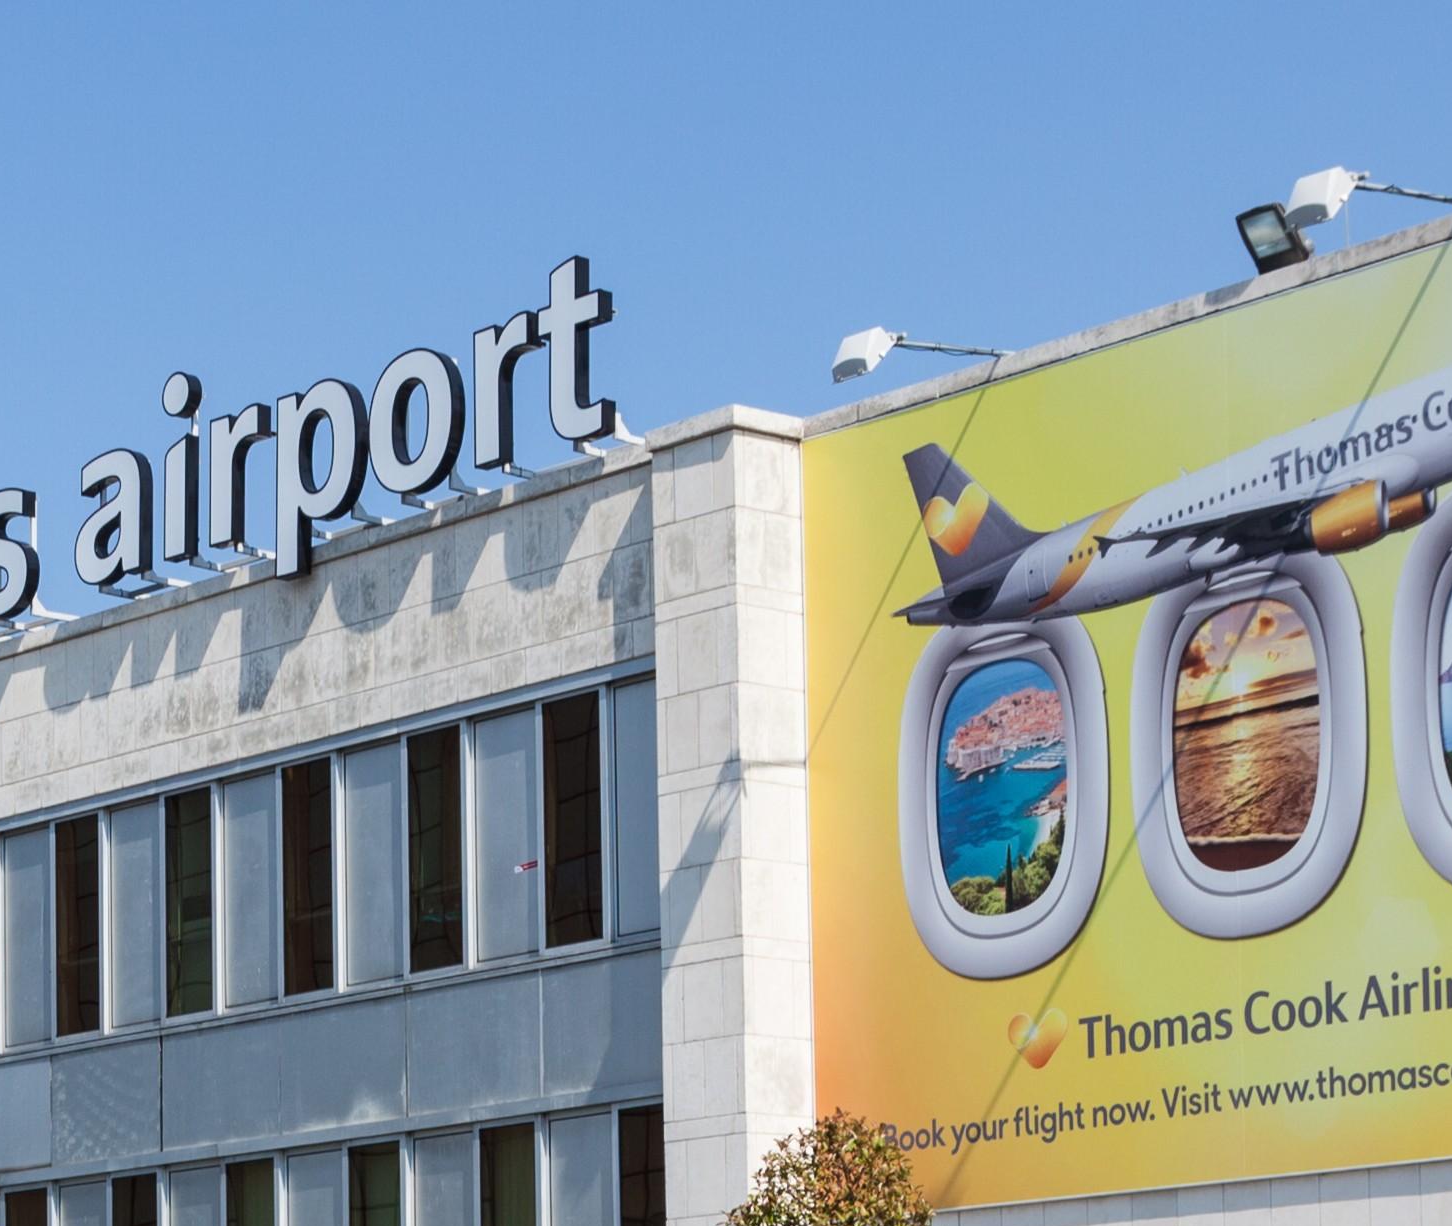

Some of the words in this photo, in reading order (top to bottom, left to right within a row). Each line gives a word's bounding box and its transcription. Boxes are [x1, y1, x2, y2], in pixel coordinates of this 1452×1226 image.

[74, 256, 614, 581] airport
[1271, 414, 1414, 492] Thomas
[1078, 1009, 1233, 1060] Thomas
[1243, 980, 1349, 1035] Cook
[950, 1118, 1009, 1156] your
[1012, 1101, 1086, 1144] flight
[1092, 1099, 1155, 1129] now.
[1161, 1084, 1223, 1119] Visit
